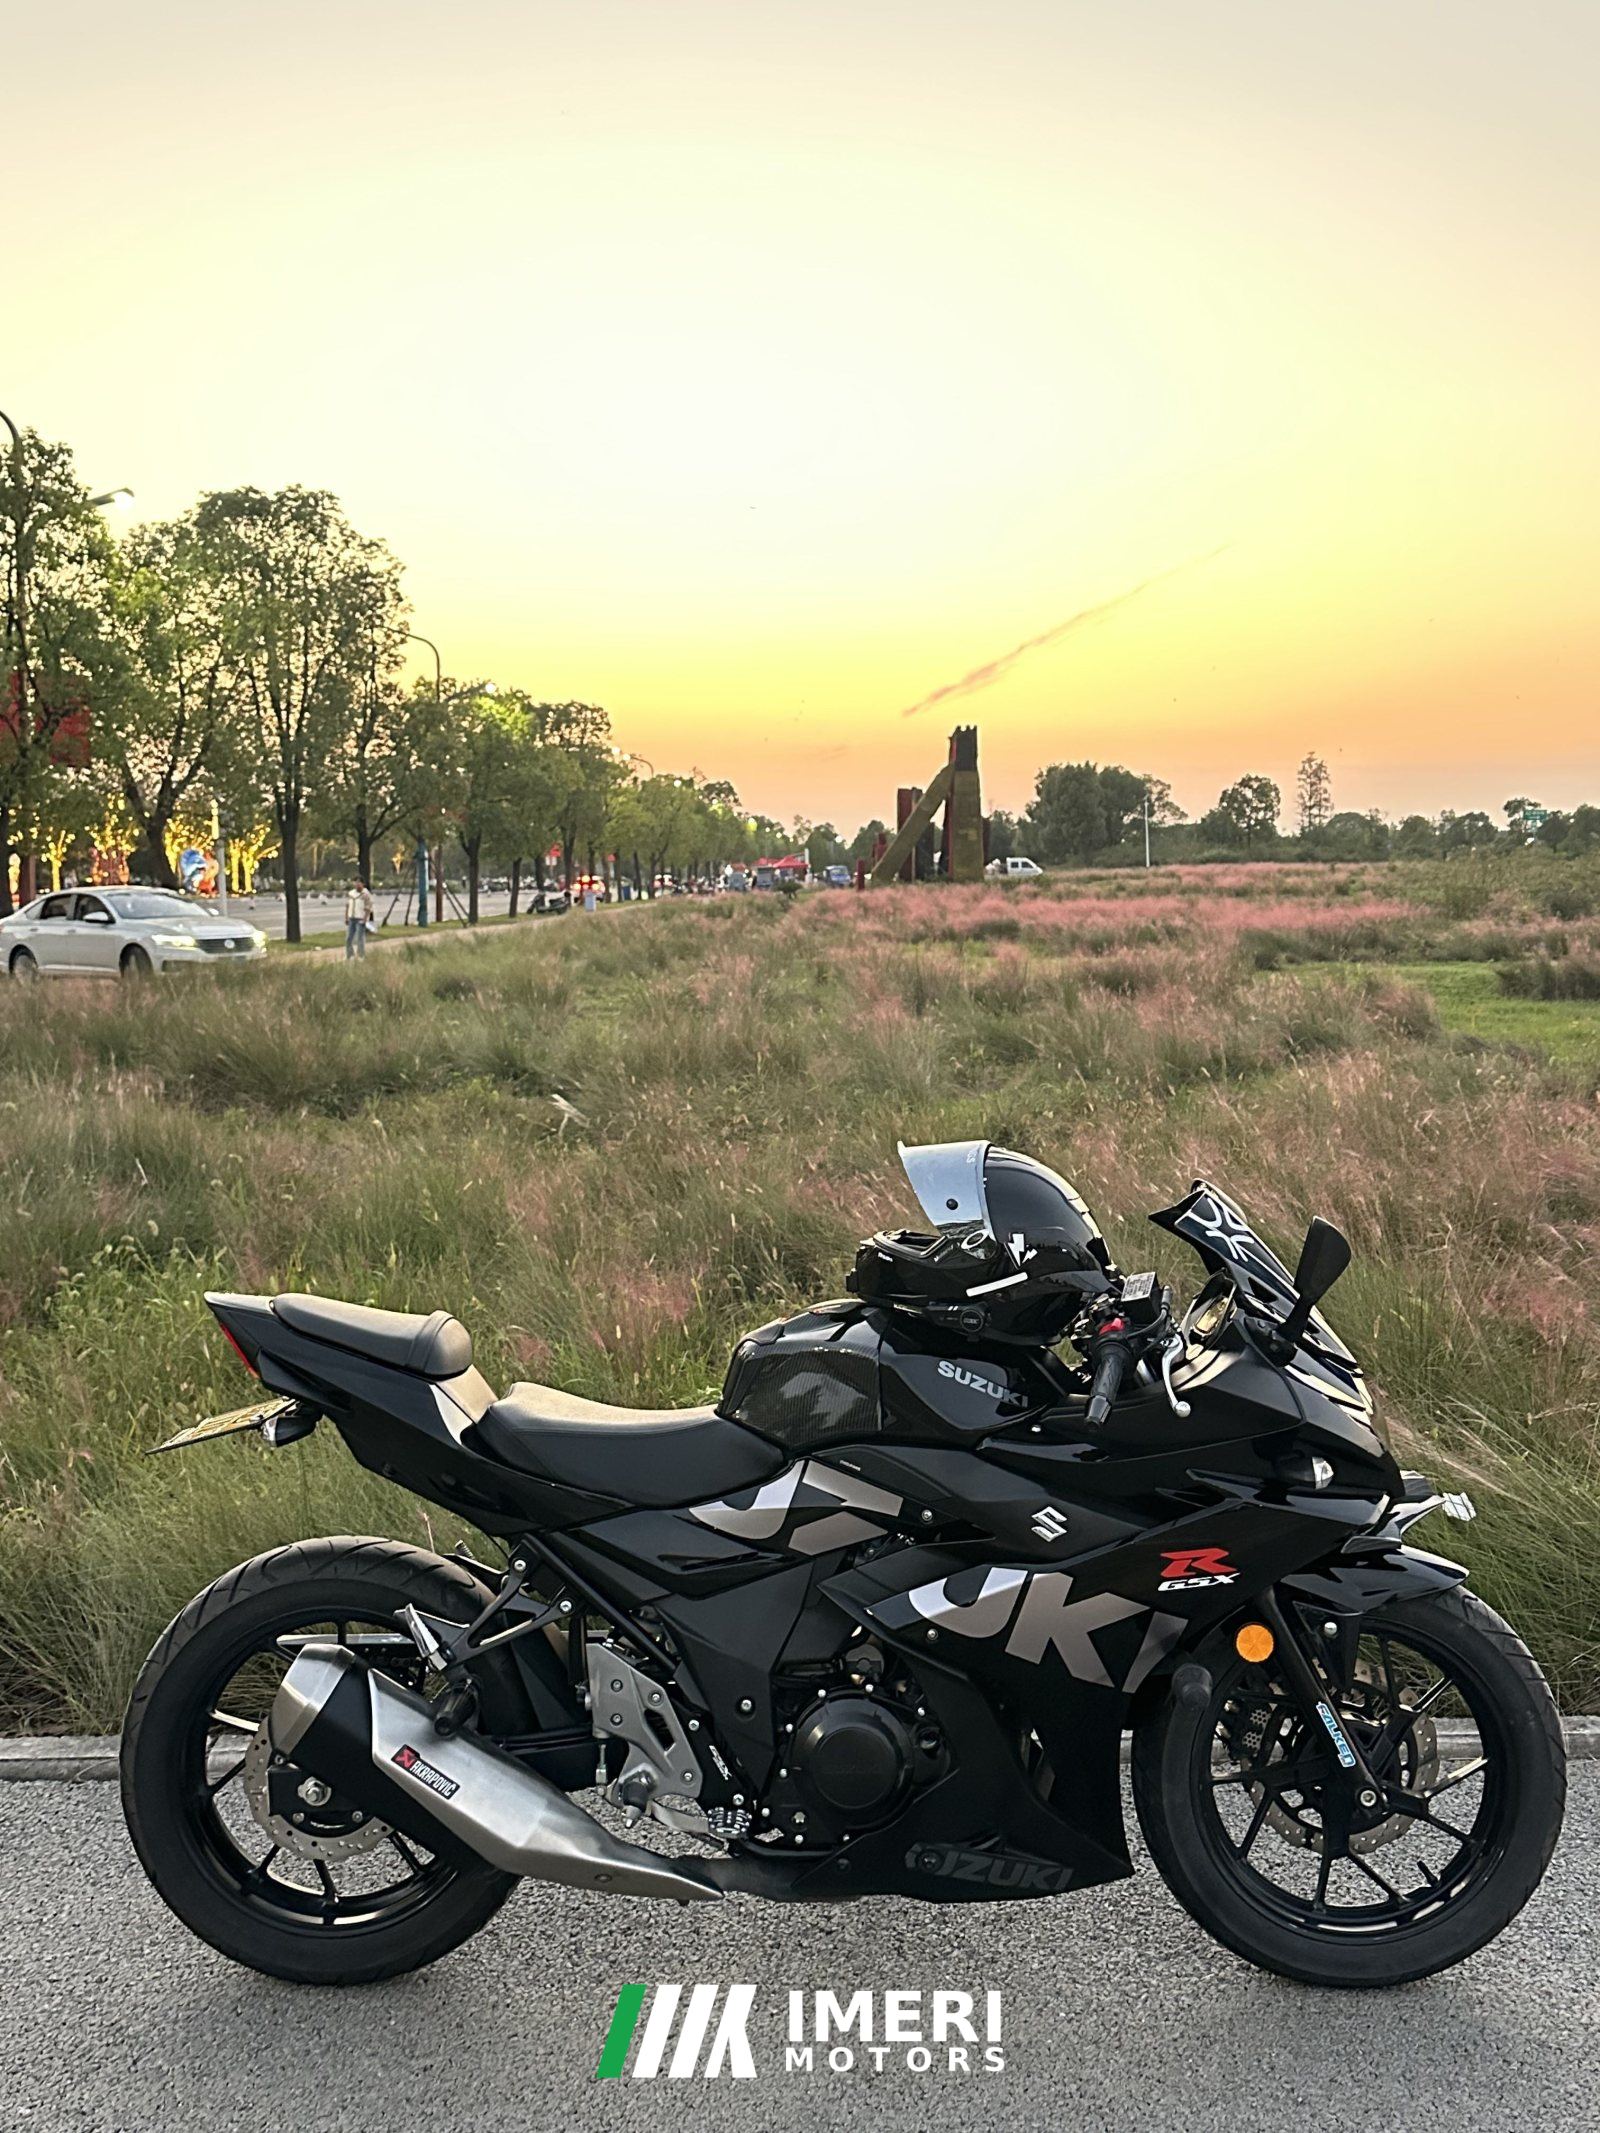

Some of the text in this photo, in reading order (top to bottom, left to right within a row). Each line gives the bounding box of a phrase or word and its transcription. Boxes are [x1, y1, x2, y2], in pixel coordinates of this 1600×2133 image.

[937, 1360, 1029, 1408] SUZUKI
[1160, 1547, 1238, 1578] R
[1157, 1572, 1241, 1592] GSX
